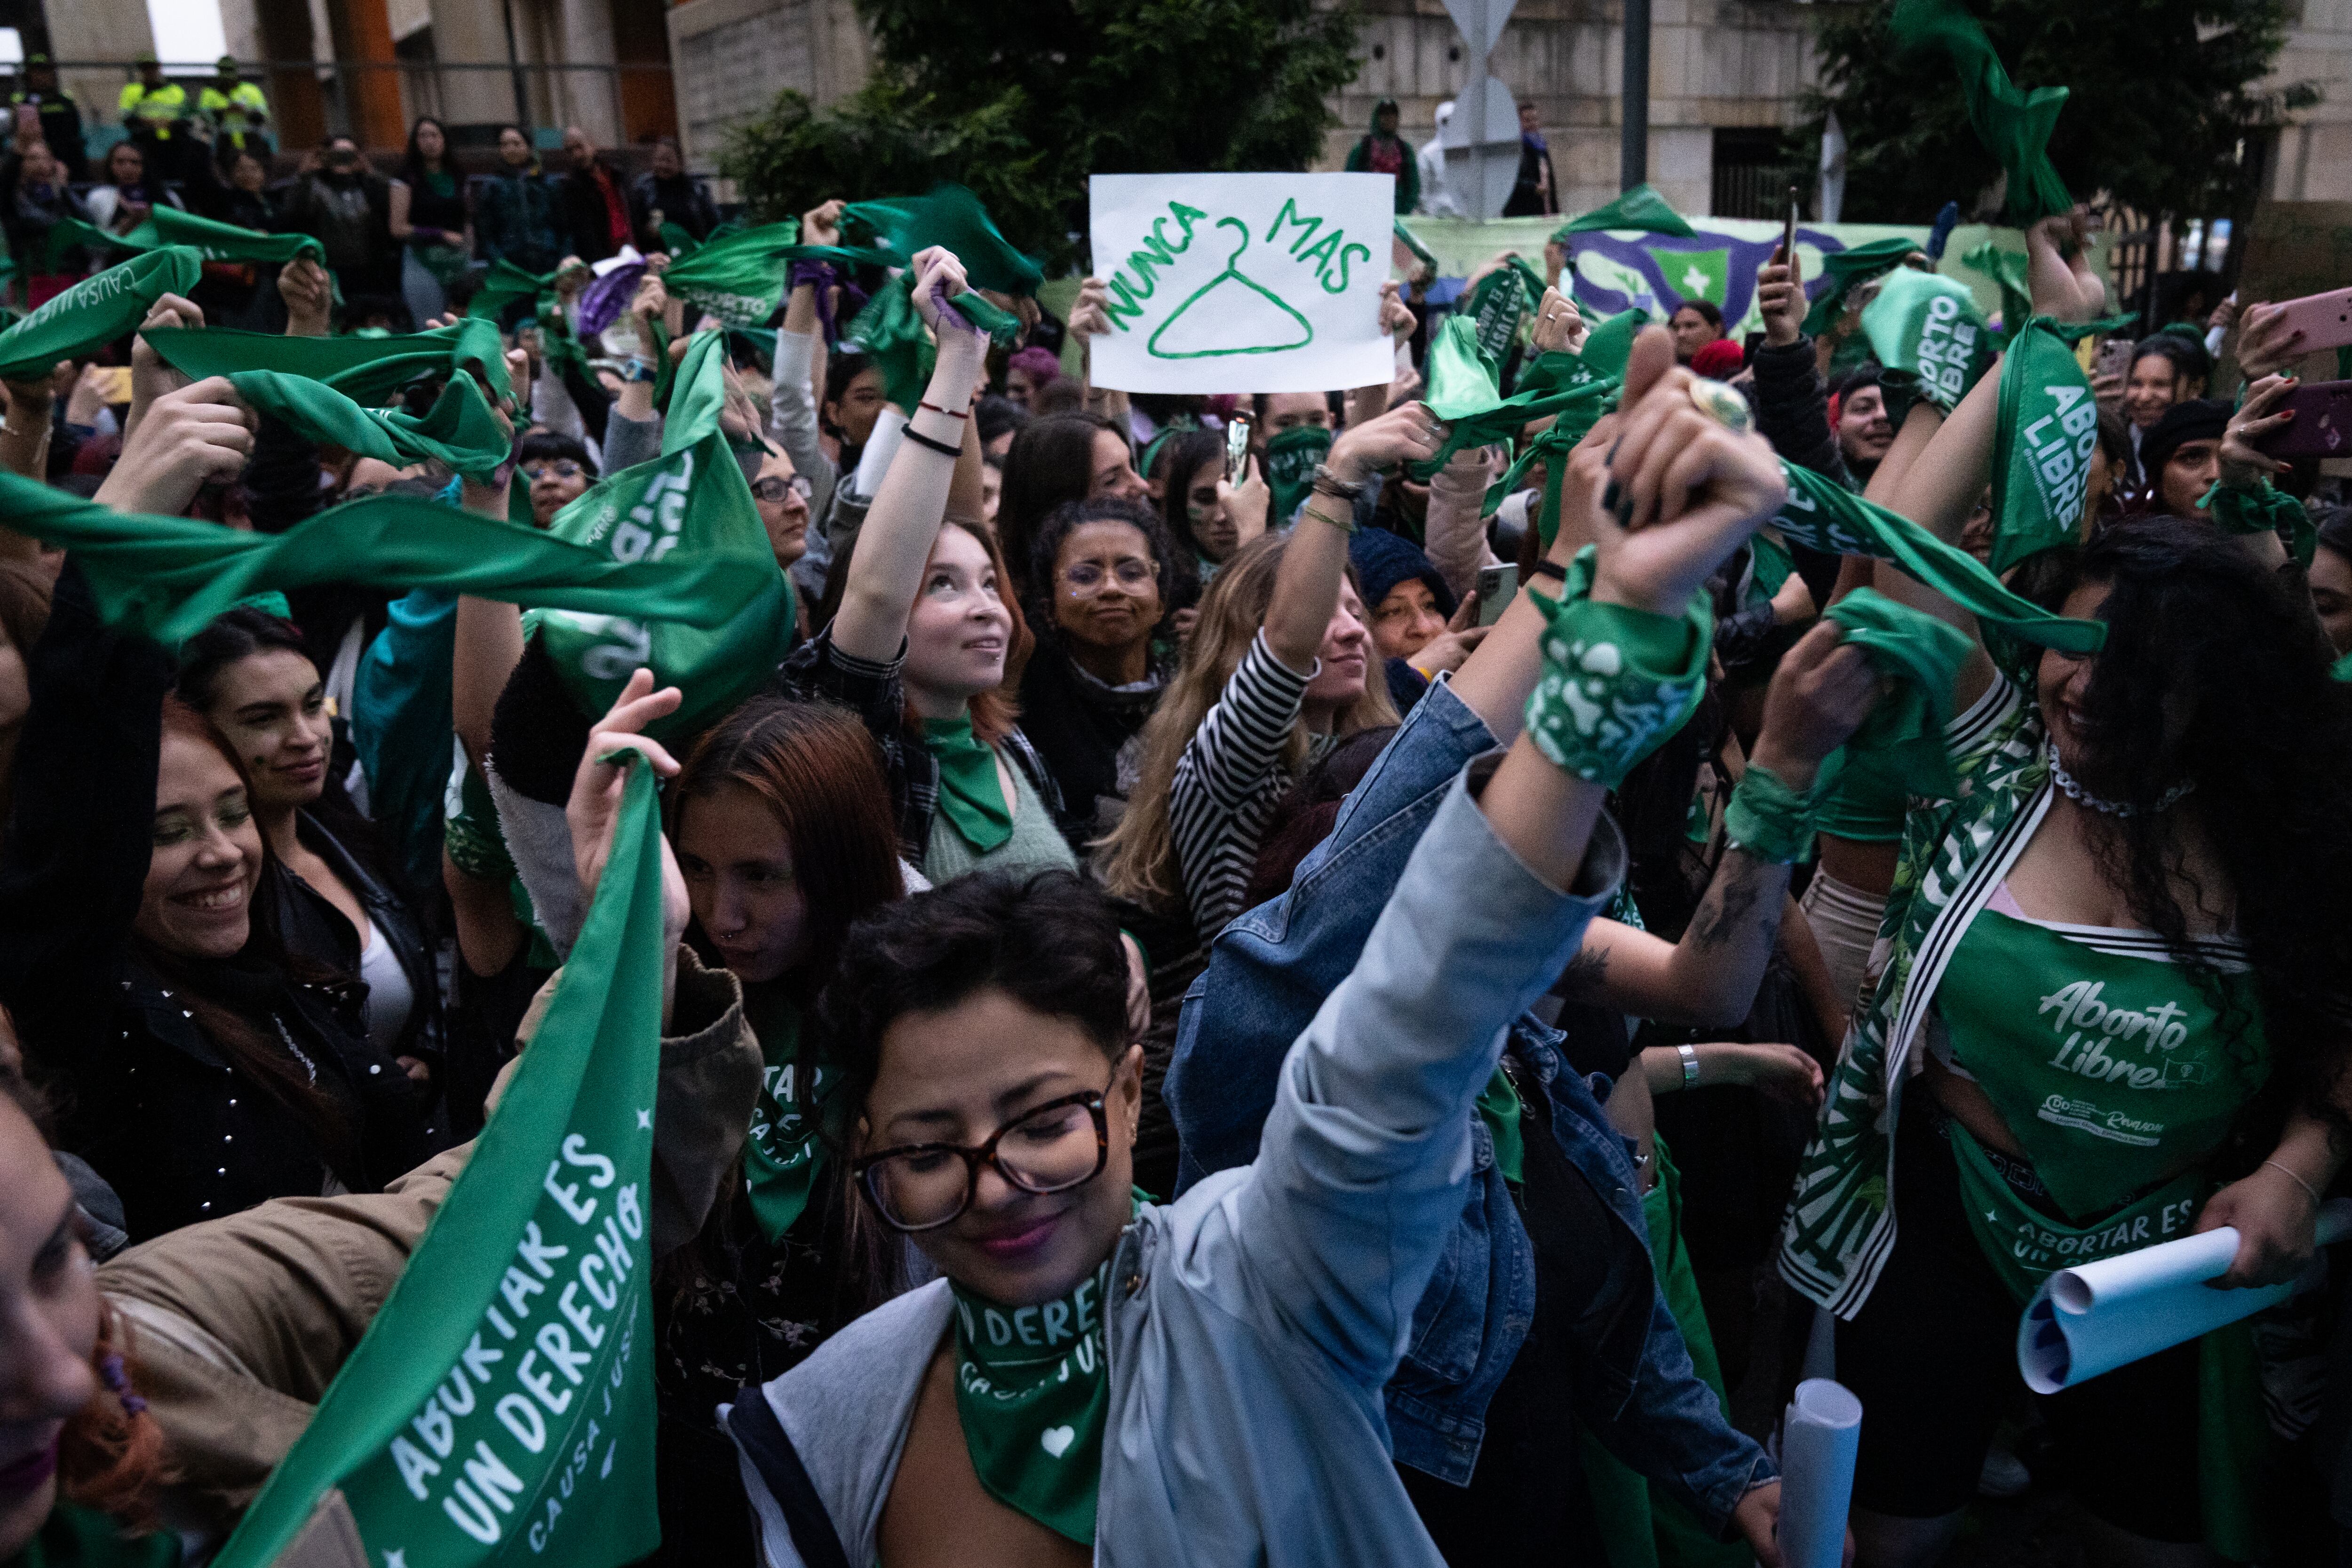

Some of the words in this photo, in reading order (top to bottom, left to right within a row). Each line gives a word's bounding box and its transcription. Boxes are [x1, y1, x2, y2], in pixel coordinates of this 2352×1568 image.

[76, 266, 135, 309] CAUSA
[1105, 200, 1208, 332] NUNCA
[1265, 198, 1371, 294] MAS
[1940, 321, 1977, 415] IBRE
[2024, 414, 2080, 533] LIBRE
[2044, 385, 2098, 520] ABOR
[2037, 981, 2188, 1053] Aborto
[2047, 1031, 2166, 1089] Libre
[543, 1132, 616, 1225] ES
[2018, 1215, 2150, 1256] ABORTAR
[2161, 1199, 2194, 1234] ES
[442, 1438, 525, 1545] UN
[528, 1425, 602, 1555] CAUSA
